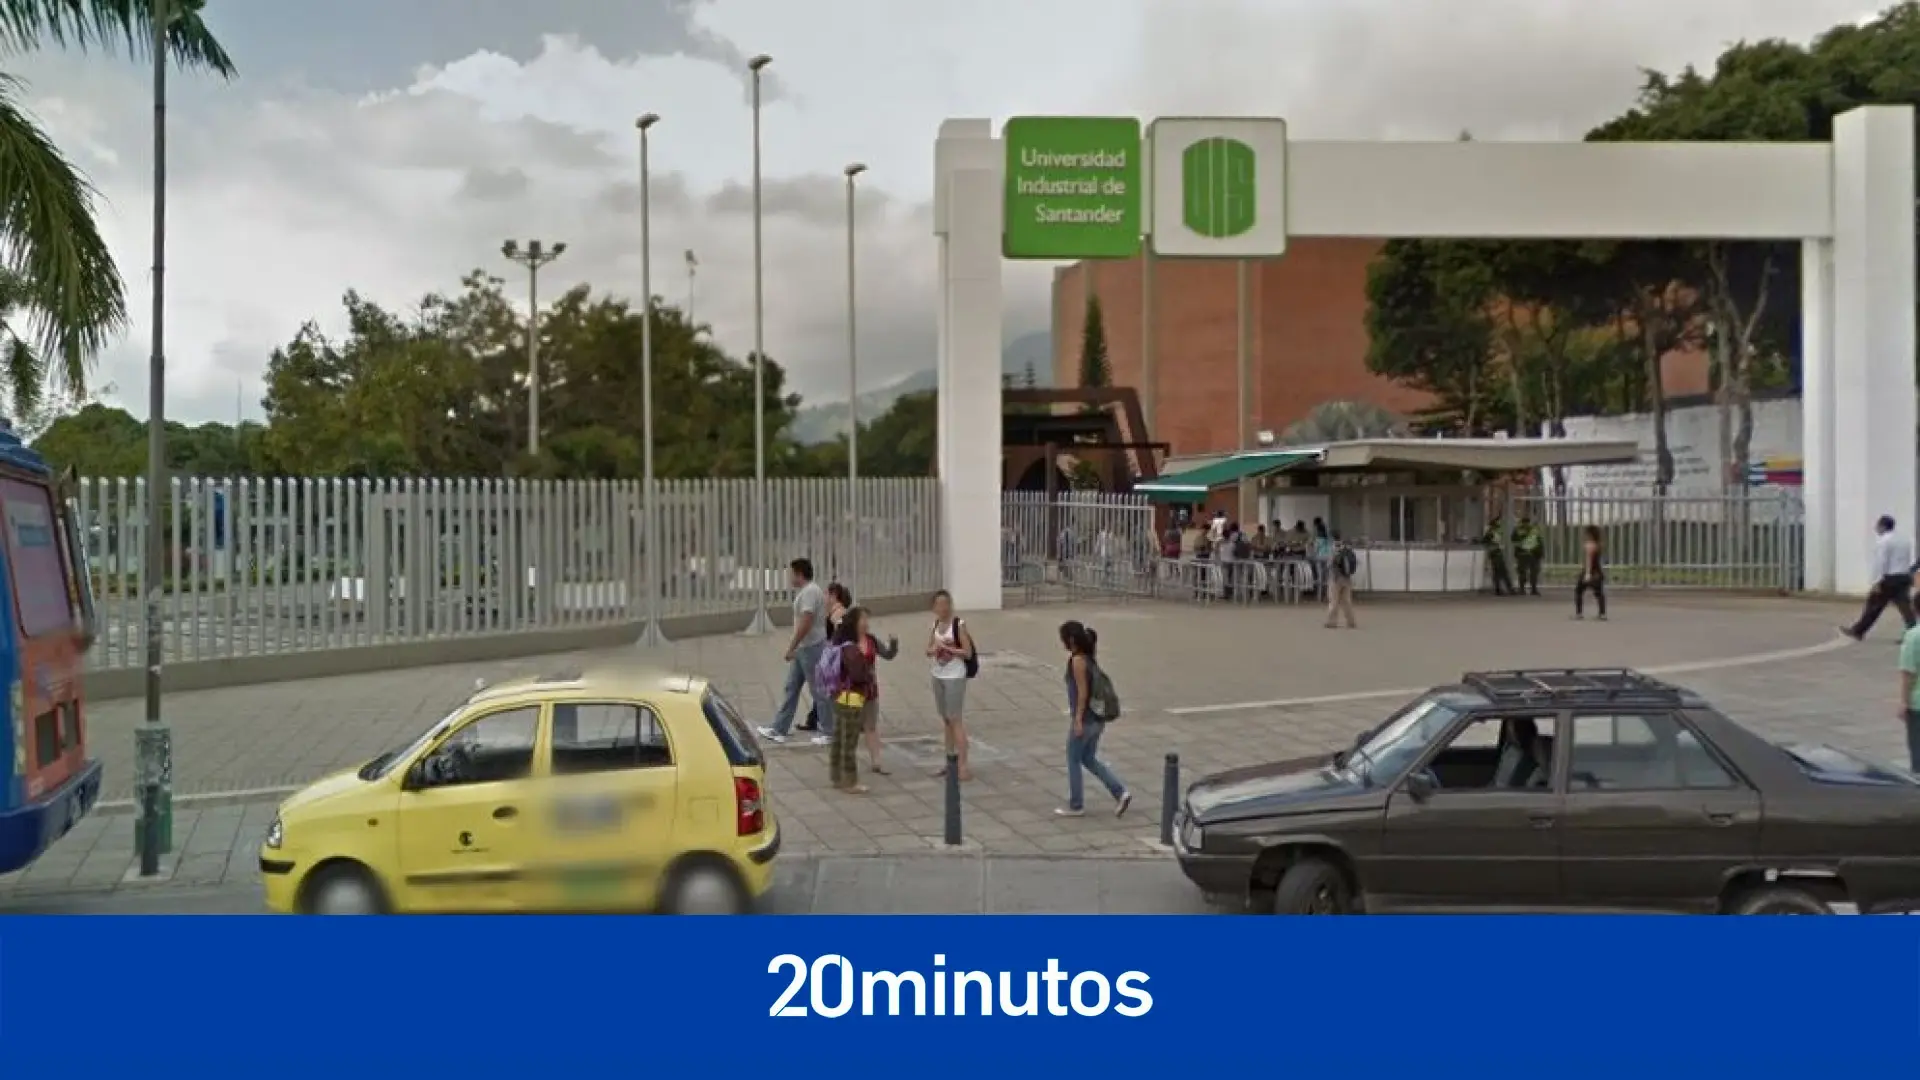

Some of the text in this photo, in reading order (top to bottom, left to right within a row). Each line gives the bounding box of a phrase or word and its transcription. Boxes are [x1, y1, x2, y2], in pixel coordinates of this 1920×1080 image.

[1021, 148, 1126, 167] Universidad
[1017, 176, 1126, 195] Industrial de
[1035, 204, 1125, 223] Santander
